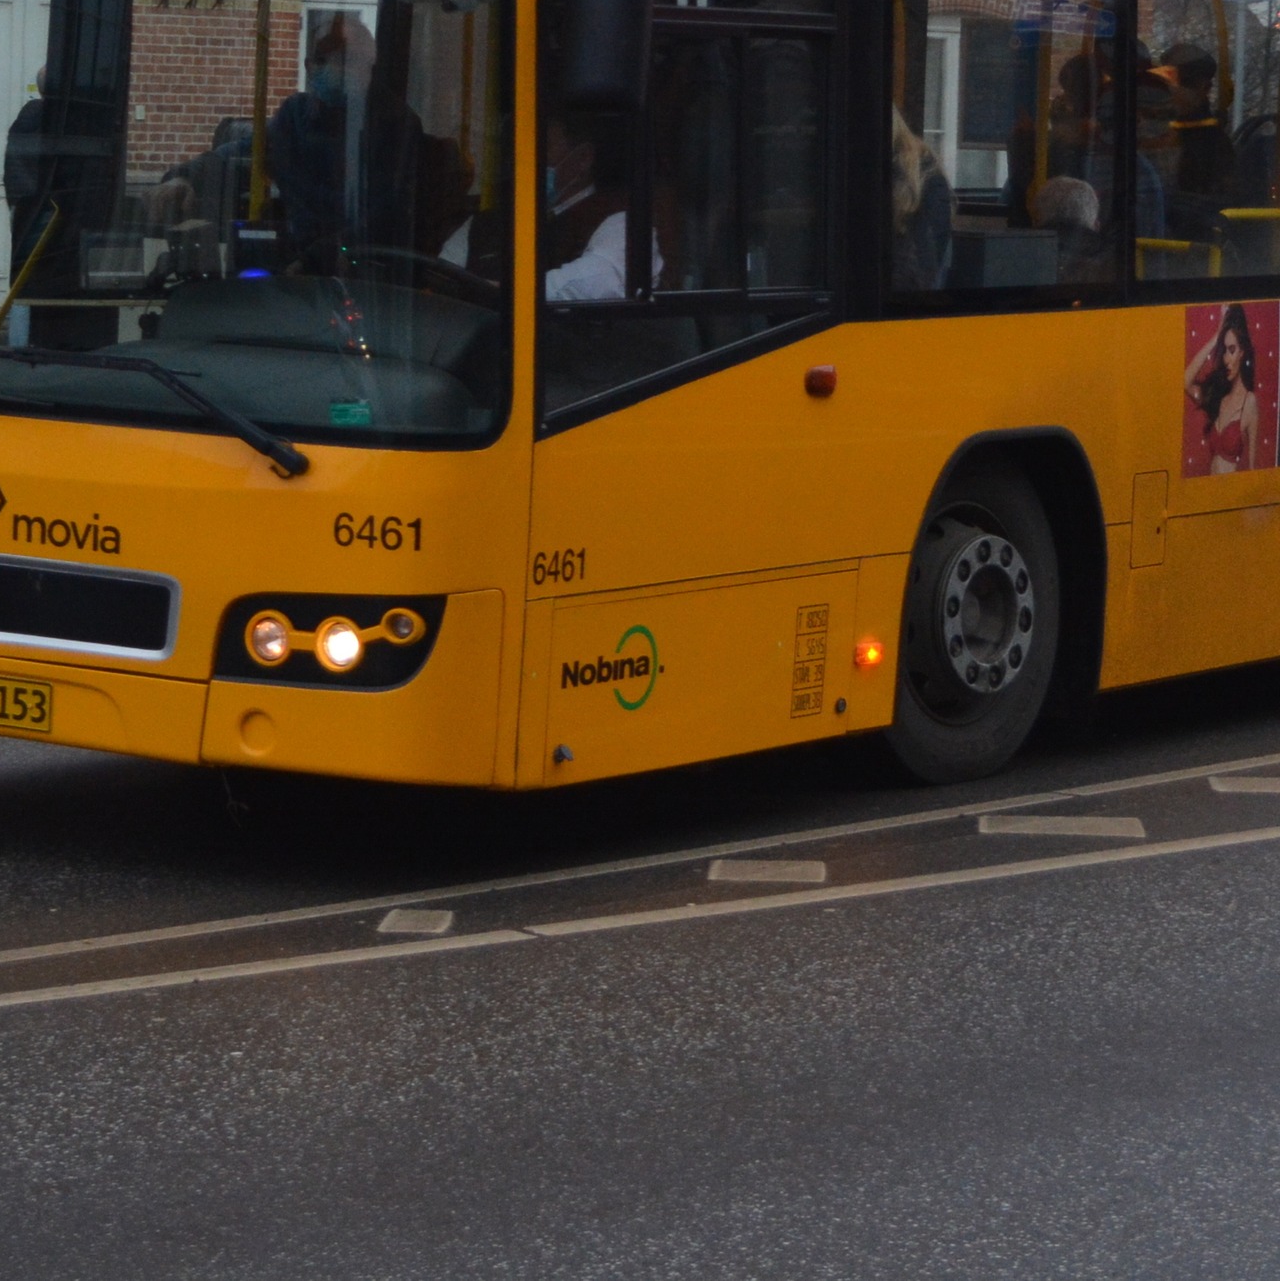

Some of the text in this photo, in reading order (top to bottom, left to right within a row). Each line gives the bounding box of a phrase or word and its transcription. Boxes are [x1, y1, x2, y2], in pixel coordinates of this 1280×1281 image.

[11, 511, 121, 554] movia
[334, 512, 422, 551] 6461
[532, 547, 586, 586] 6461
